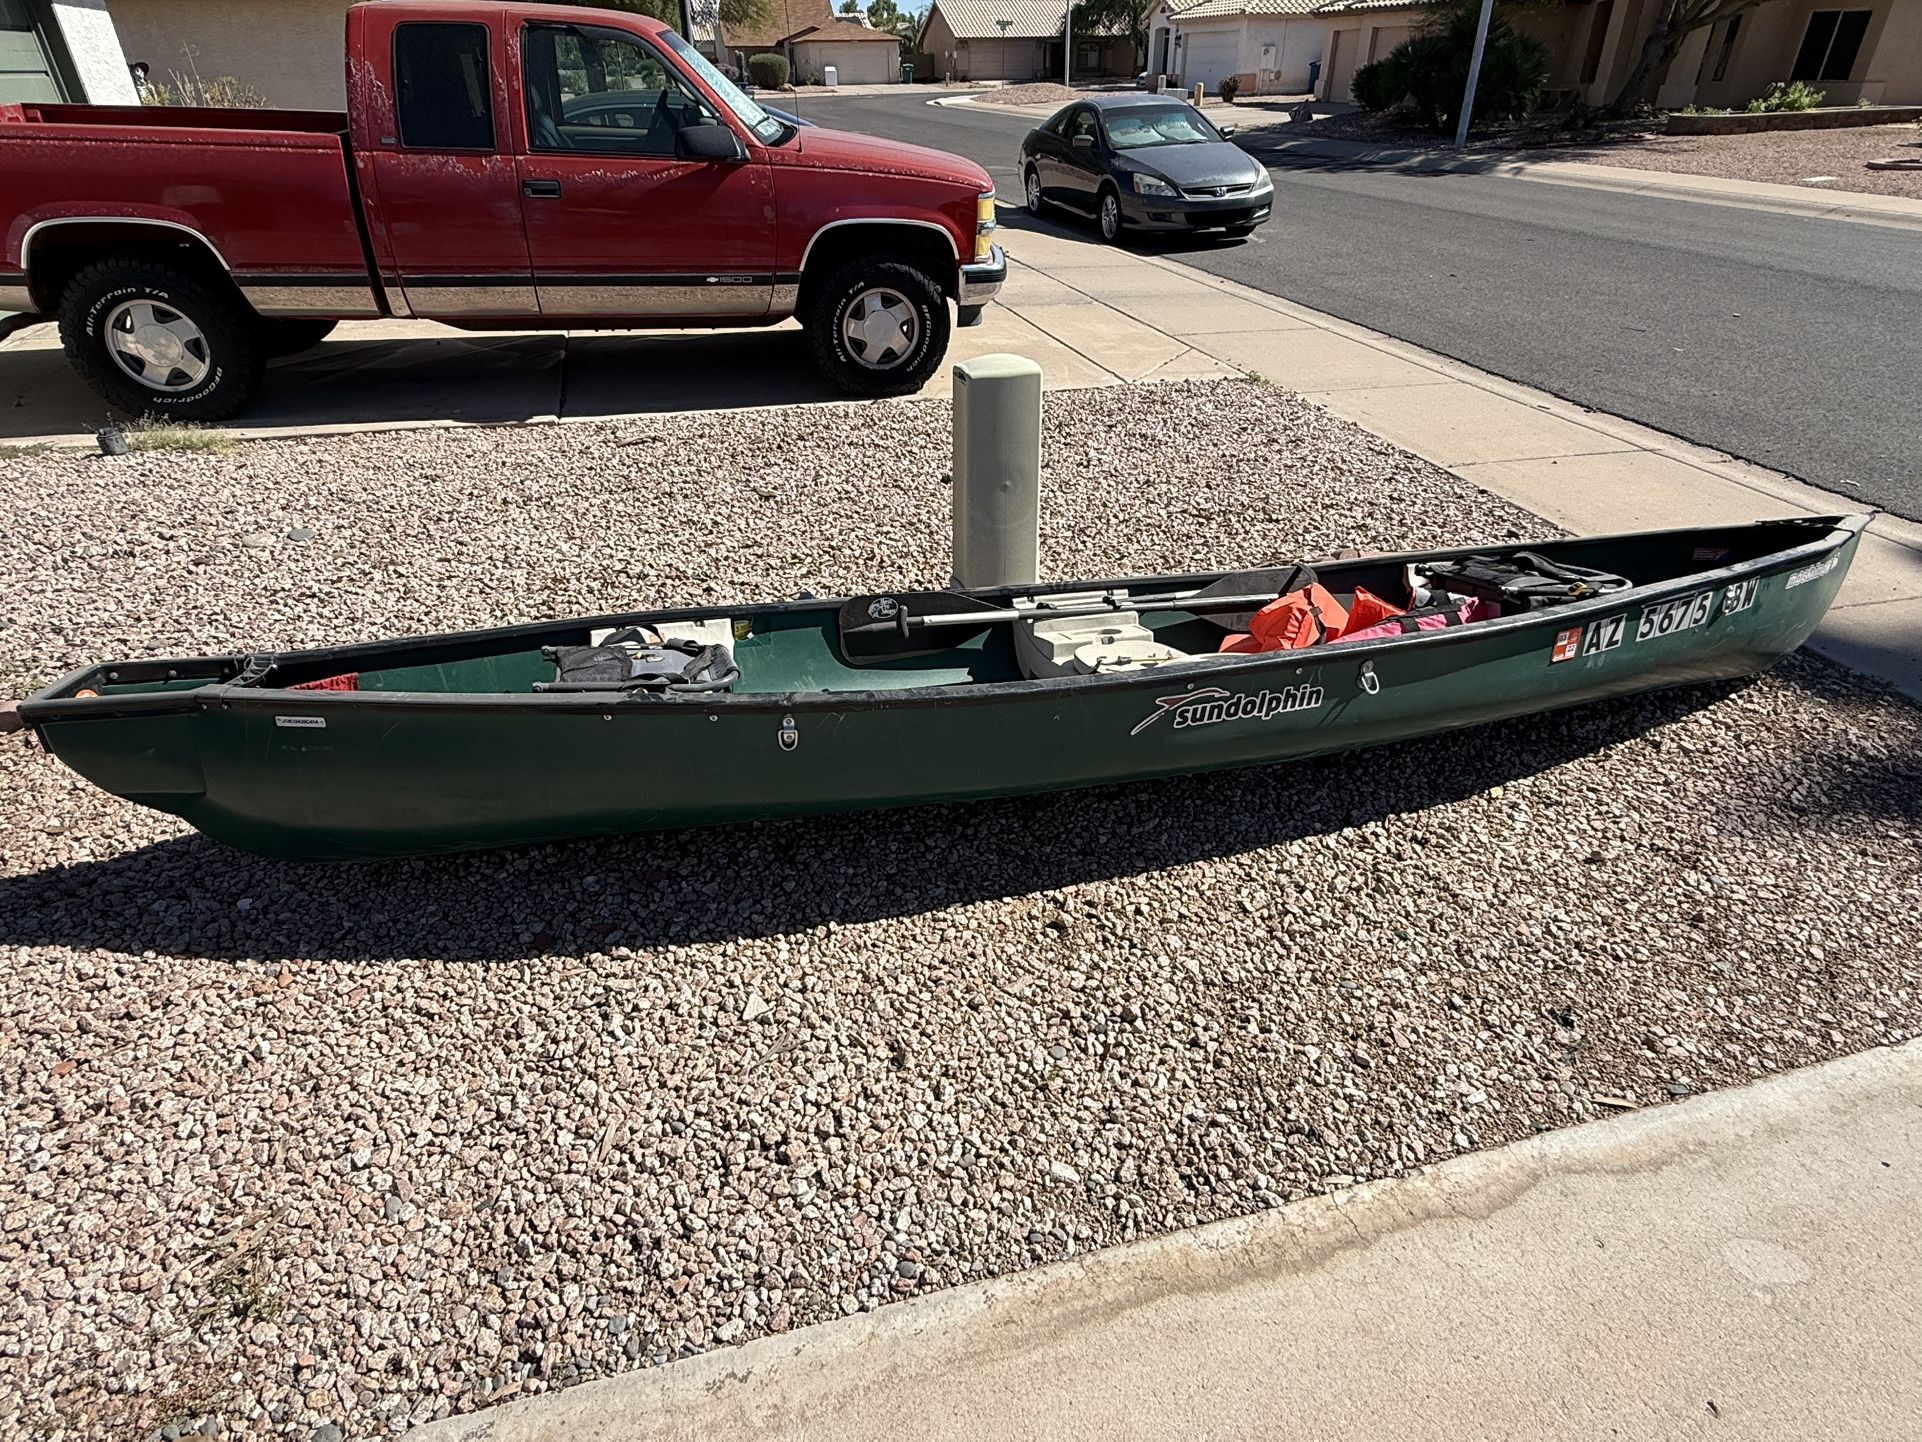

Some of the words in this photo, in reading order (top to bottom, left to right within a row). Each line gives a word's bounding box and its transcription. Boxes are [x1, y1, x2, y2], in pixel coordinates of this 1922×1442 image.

[143, 286, 169, 299] T/A
[1583, 616, 1625, 655] AZ
[1637, 593, 1712, 641] 5675
[1173, 683, 1324, 728] sundolphin
